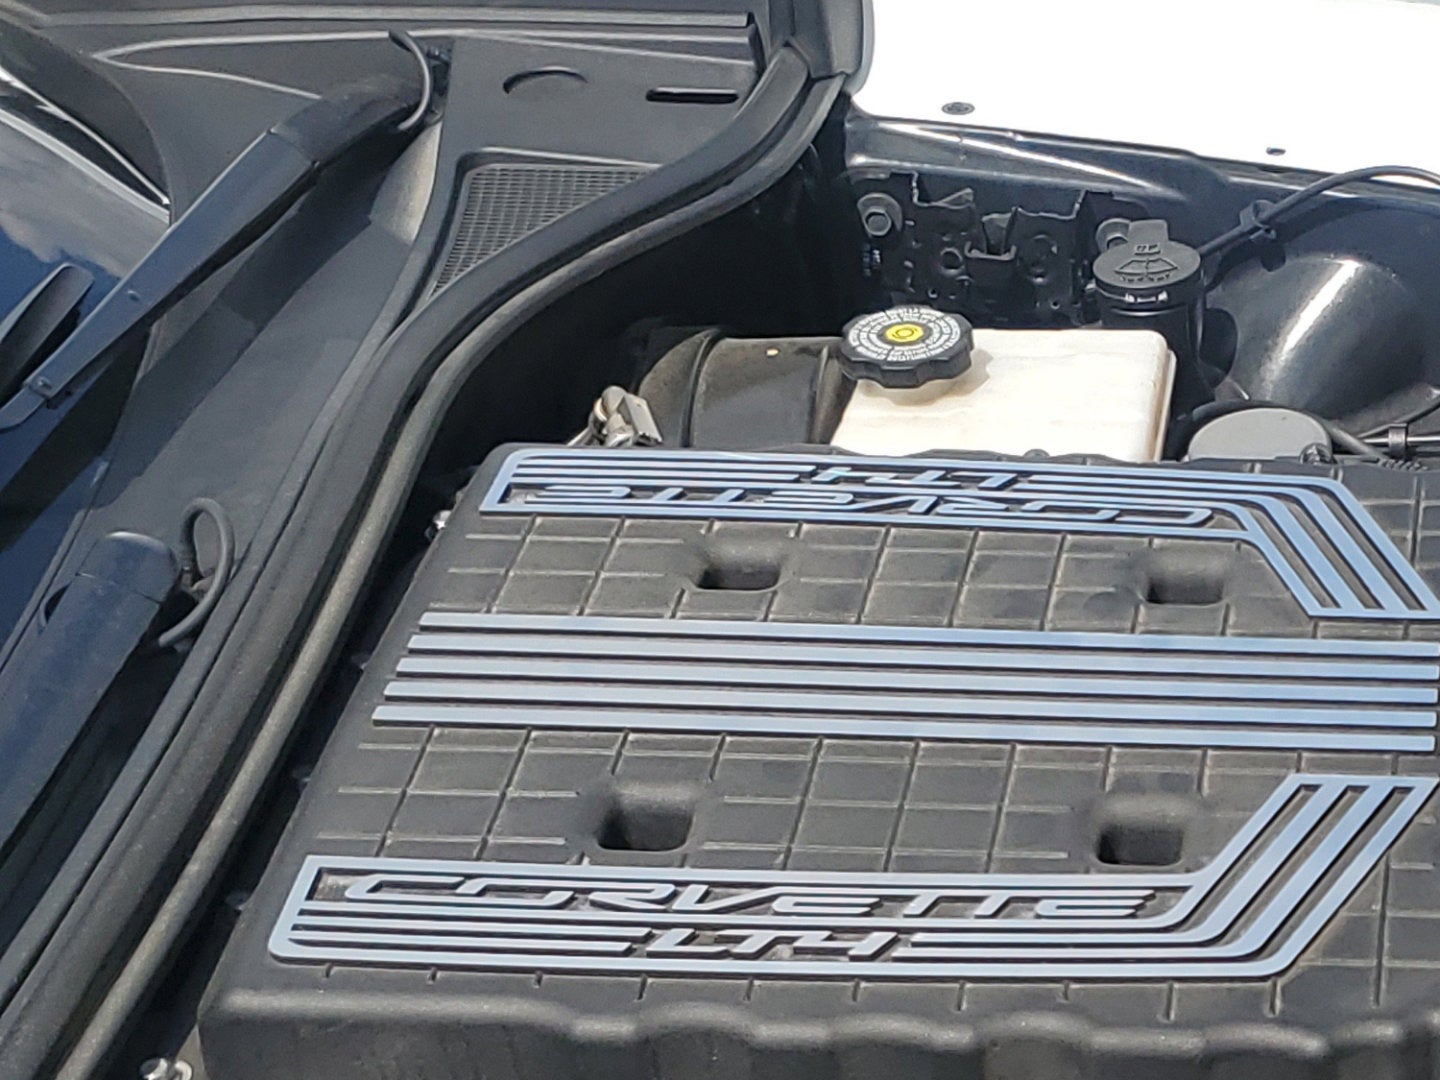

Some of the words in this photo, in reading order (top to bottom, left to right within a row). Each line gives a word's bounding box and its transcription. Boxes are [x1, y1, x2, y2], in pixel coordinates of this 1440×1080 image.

[811, 467, 1018, 489] LT4
[525, 486, 1212, 526] CORVETTE
[345, 874, 1155, 917] CORVETTE
[646, 928, 898, 959] LT4
